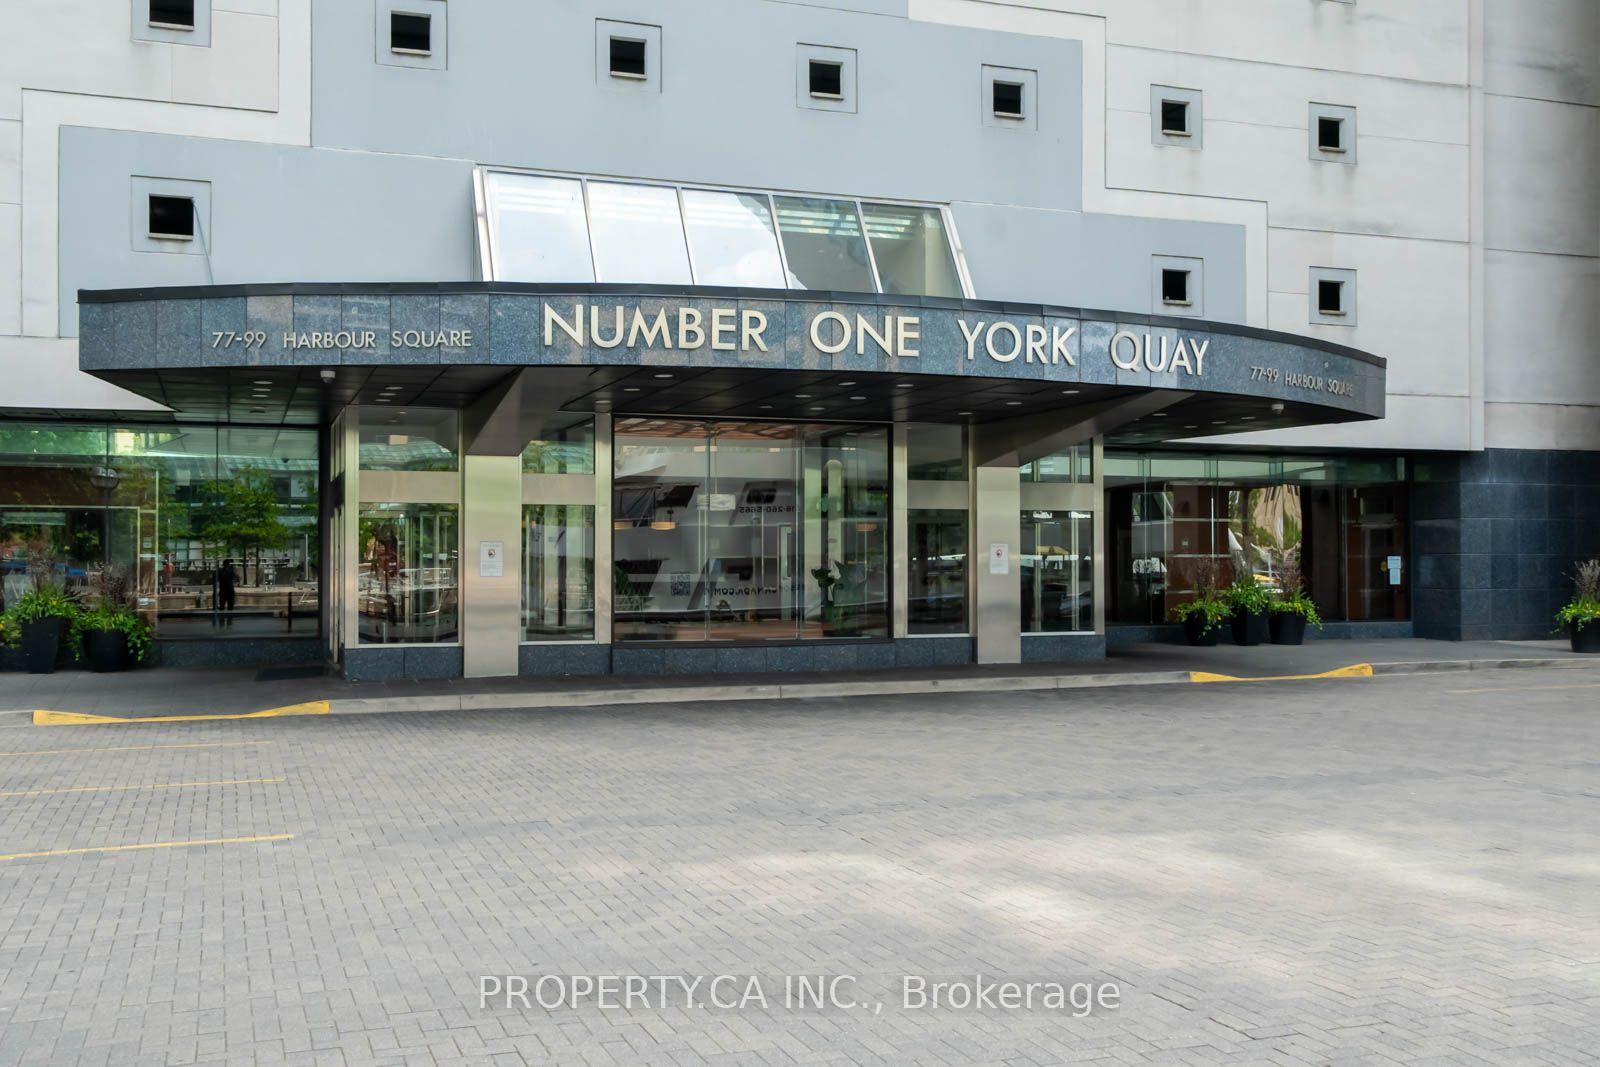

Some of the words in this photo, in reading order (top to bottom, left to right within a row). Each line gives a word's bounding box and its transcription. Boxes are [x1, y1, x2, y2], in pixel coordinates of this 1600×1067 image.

[212, 331, 267, 348] 77-99
[283, 331, 376, 349] HARBOUR
[391, 330, 472, 348] SQUARE
[544, 302, 768, 352] NUMBER
[809, 311, 920, 357] ONE
[957, 319, 1077, 366] YORK
[1110, 330, 1209, 376] QUAY
[1250, 365, 1279, 383] 77-99
[1284, 371, 1323, 391] HARBOUR
[1327, 378, 1353, 397] SQUARE
